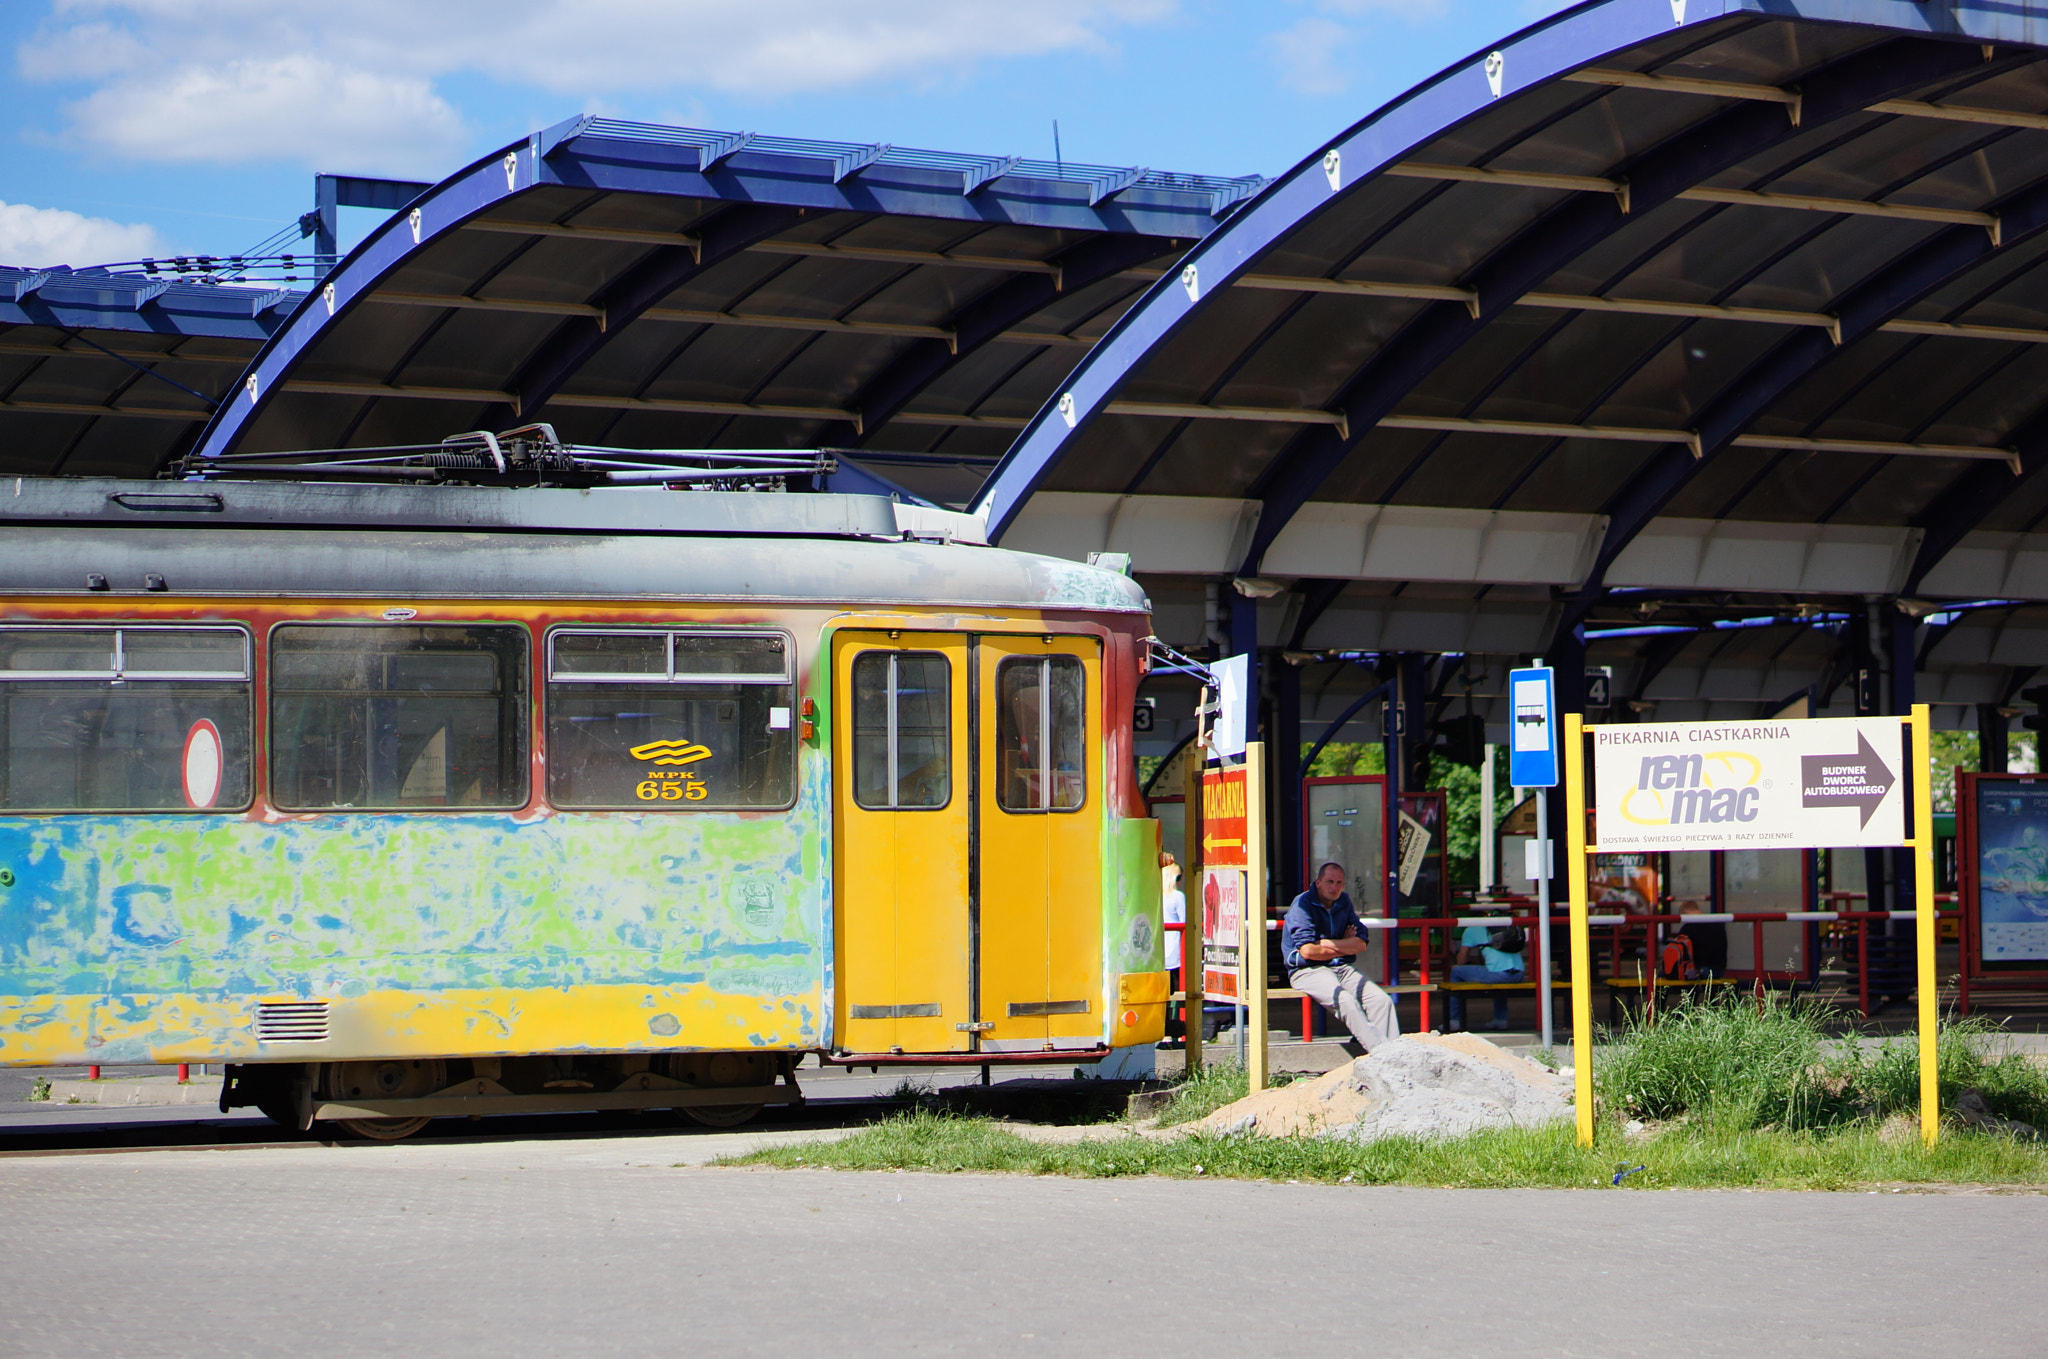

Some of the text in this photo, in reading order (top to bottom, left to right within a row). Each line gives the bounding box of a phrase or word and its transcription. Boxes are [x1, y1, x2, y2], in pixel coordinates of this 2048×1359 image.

[1589, 679, 1606, 703] 4
[1136, 709, 1150, 730] 3
[1599, 726, 1791, 745] PIEKARNIA CIASTKARNIA
[648, 771, 696, 779] MPK
[1638, 753, 1703, 790] ren
[1822, 765, 1867, 776] BUDYNEK
[1823, 775, 1866, 786] DWORCA
[635, 780, 709, 801] 655
[1804, 785, 1886, 796] AUTOBUSOWEGO
[1670, 786, 1760, 825] mac
[1602, 836, 1640, 844] DOSTAWA
[1643, 834, 1682, 843] ŚWIEŻEGO
[1685, 834, 1723, 842] PIECZYWA
[1758, 832, 1794, 840] DZIENNIE
